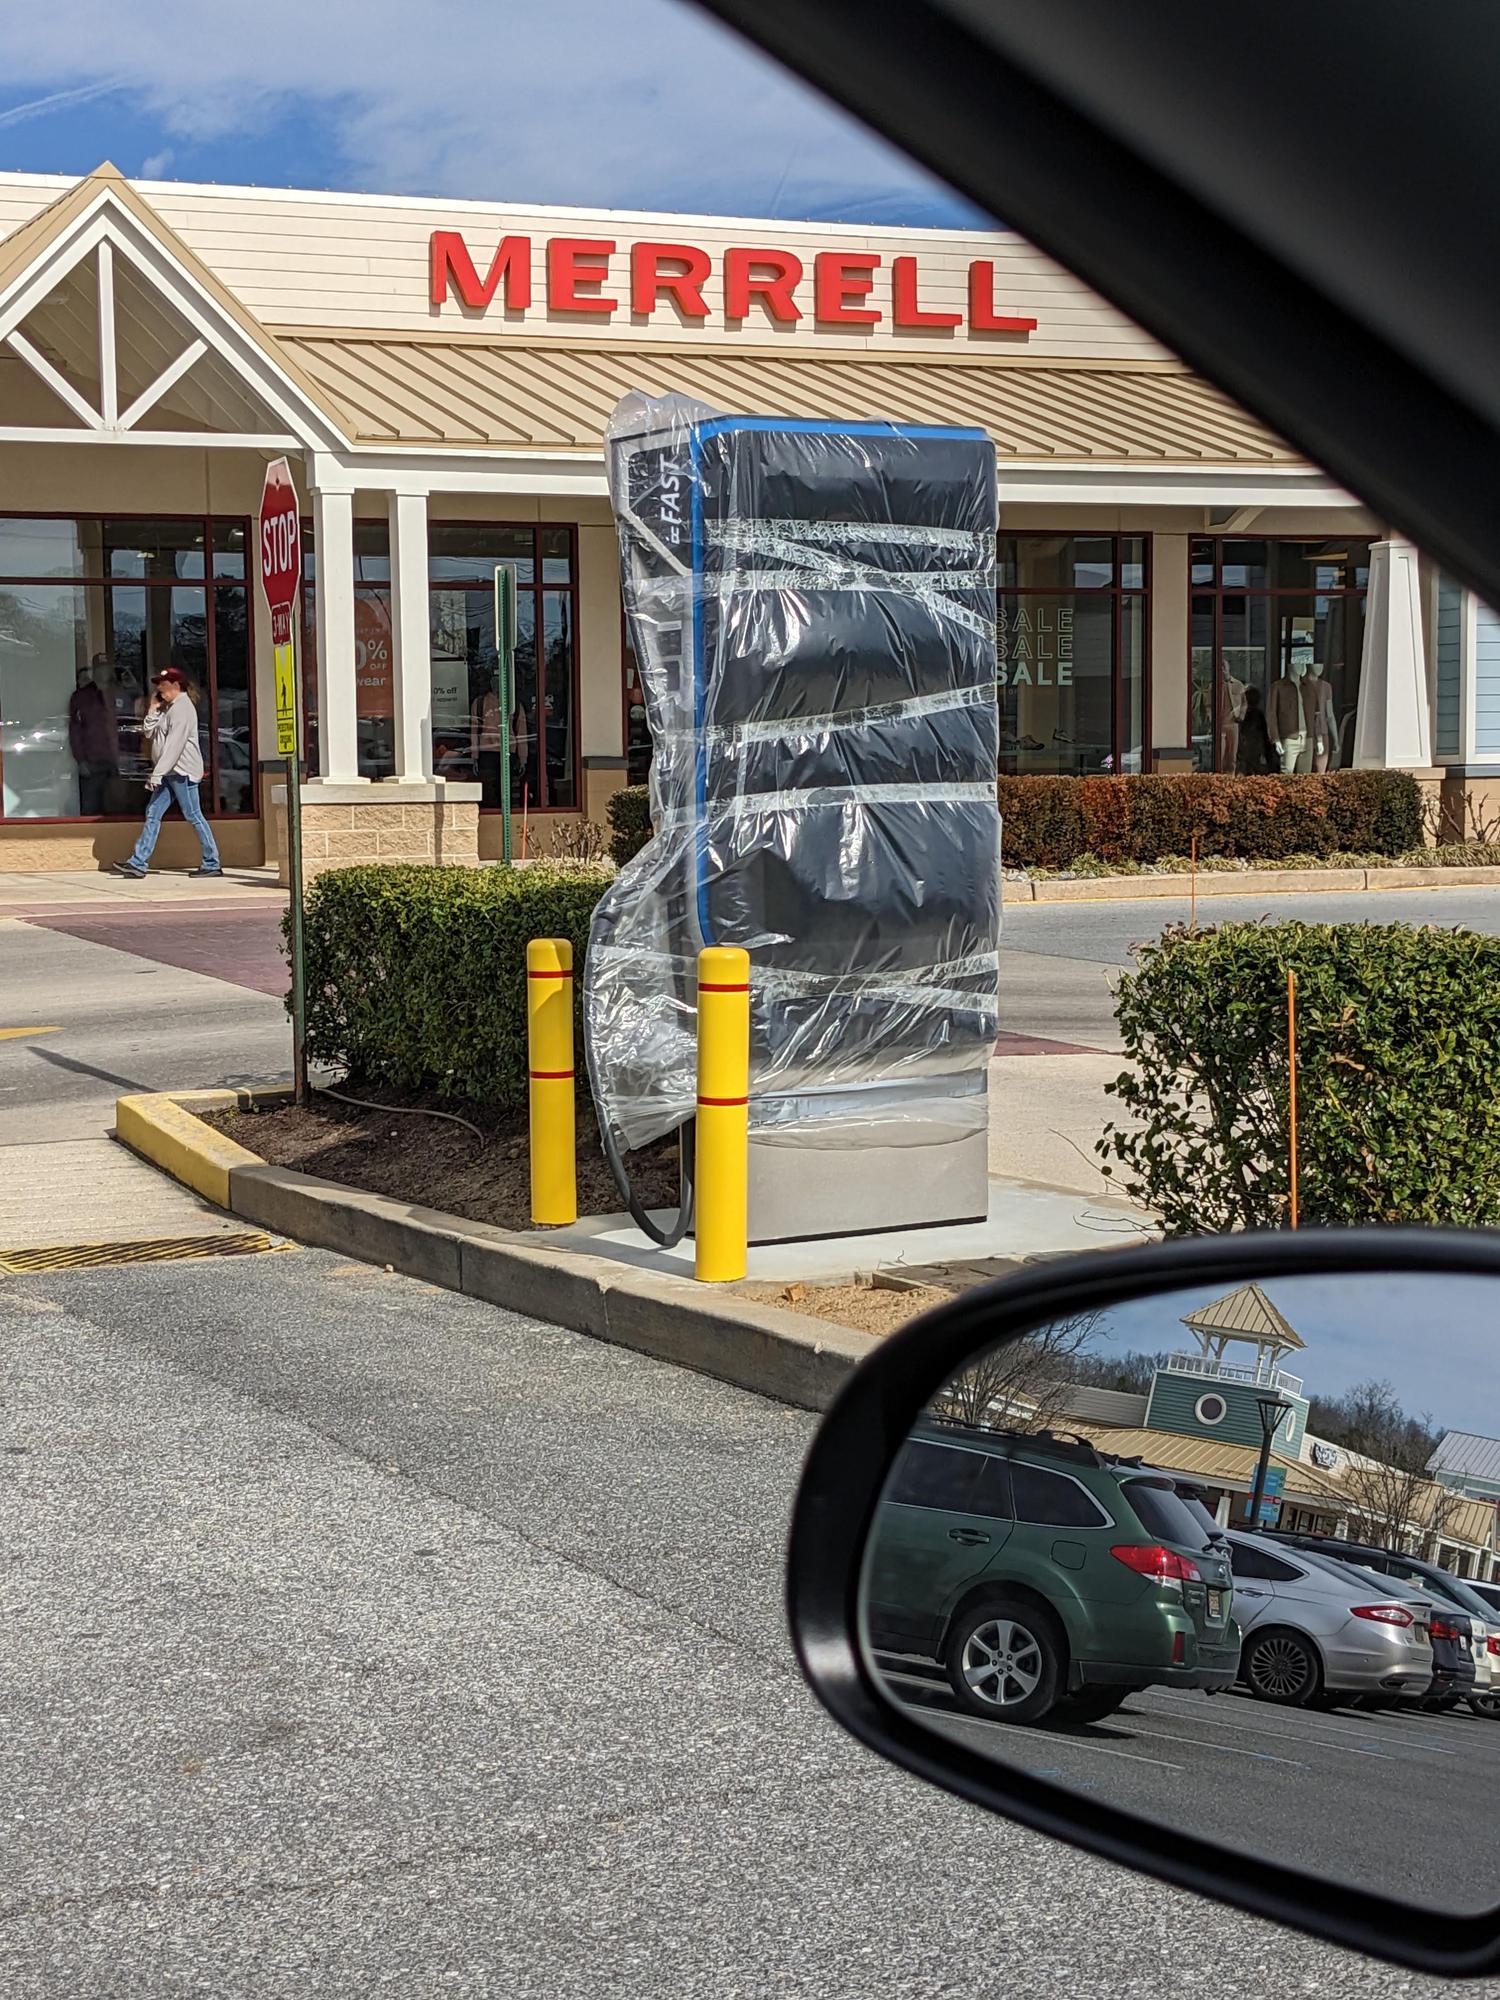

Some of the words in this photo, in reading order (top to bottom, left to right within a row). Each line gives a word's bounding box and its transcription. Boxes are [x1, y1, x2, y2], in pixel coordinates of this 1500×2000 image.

[431, 230, 1037, 331] MERRELL
[660, 453, 682, 525] FAST
[263, 510, 296, 577] STOP
[273, 611, 290, 637] 3-WAY
[996, 608, 1073, 632] SALE
[996, 635, 1073, 659] SALE
[996, 662, 1073, 686] SALE
